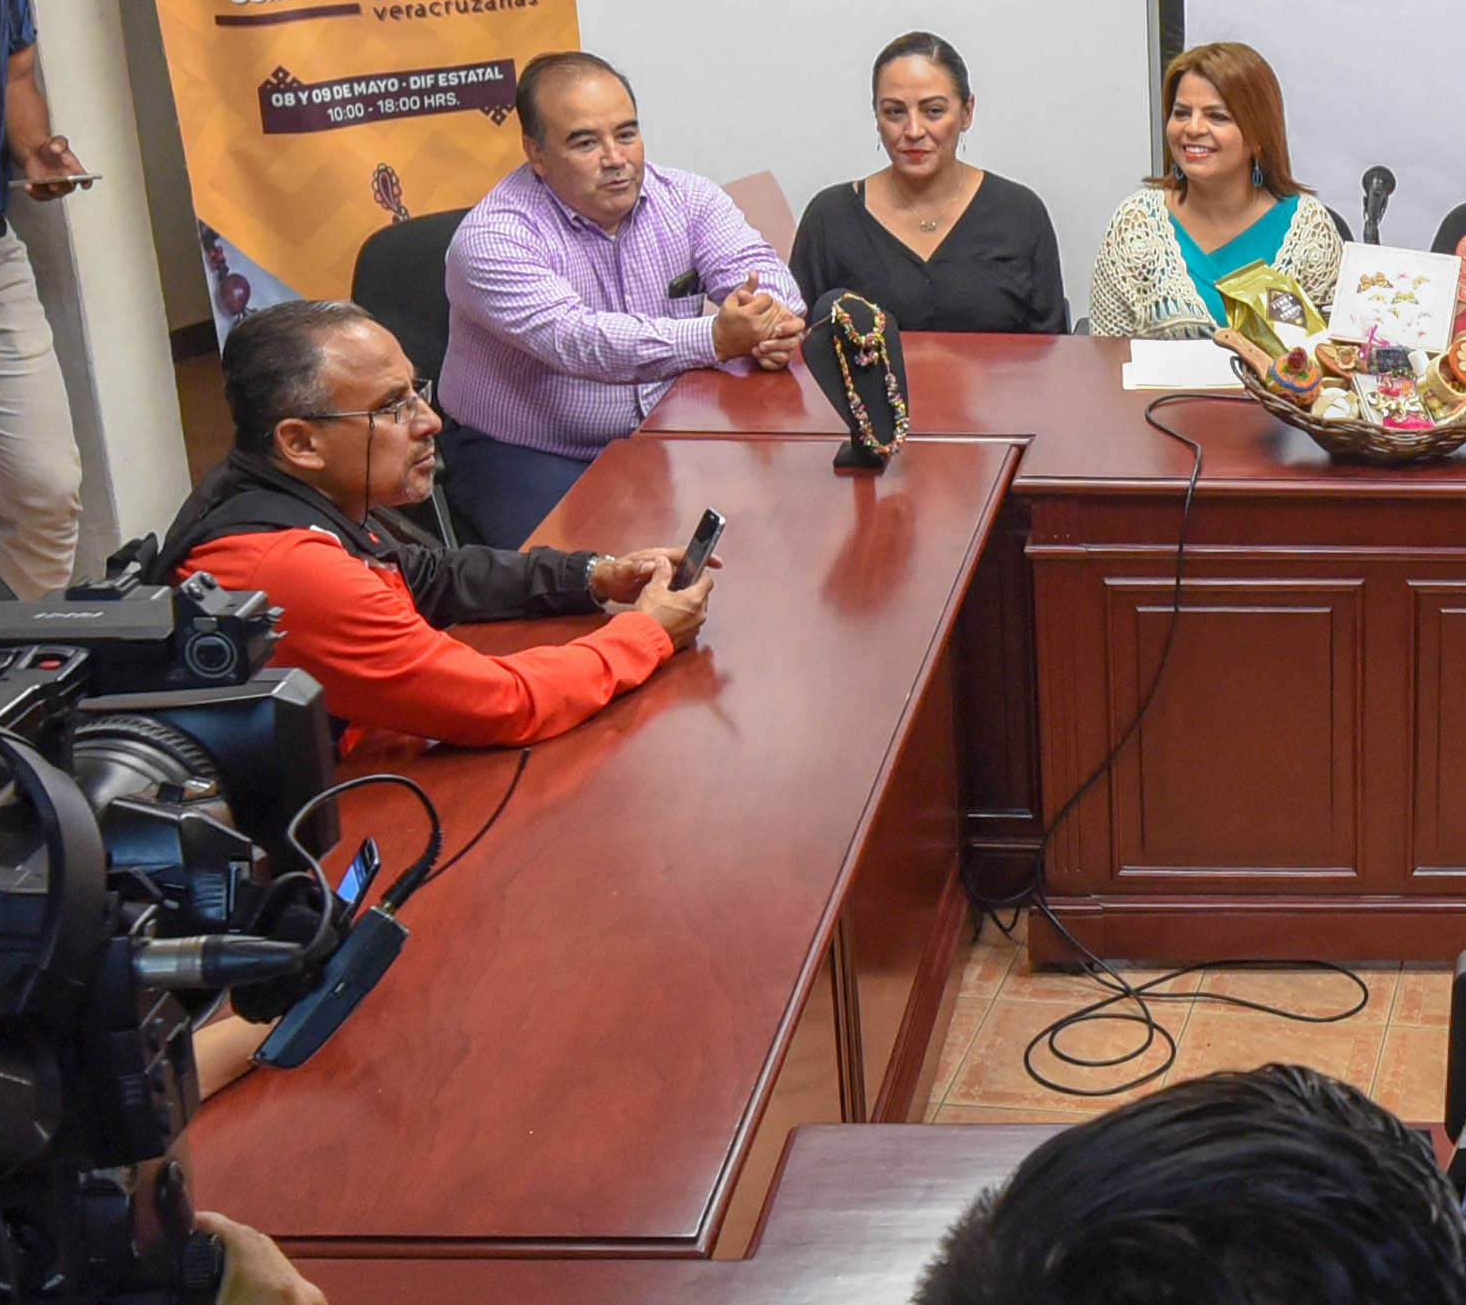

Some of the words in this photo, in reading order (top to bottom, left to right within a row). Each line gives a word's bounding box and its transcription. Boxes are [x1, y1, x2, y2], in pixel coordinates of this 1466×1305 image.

[271, 92, 295, 107] 08
[297, 91, 310, 105] Y
[312, 88, 332, 103] 09
[334, 84, 352, 100] DE
[353, 77, 400, 96] MAYO
[410, 73, 435, 90] DIF
[438, 66, 504, 87] ESTATAL
[327, 106, 365, 122] 10:00
[379, 96, 420, 114] 18:00
[424, 92, 461, 108] HRS.
